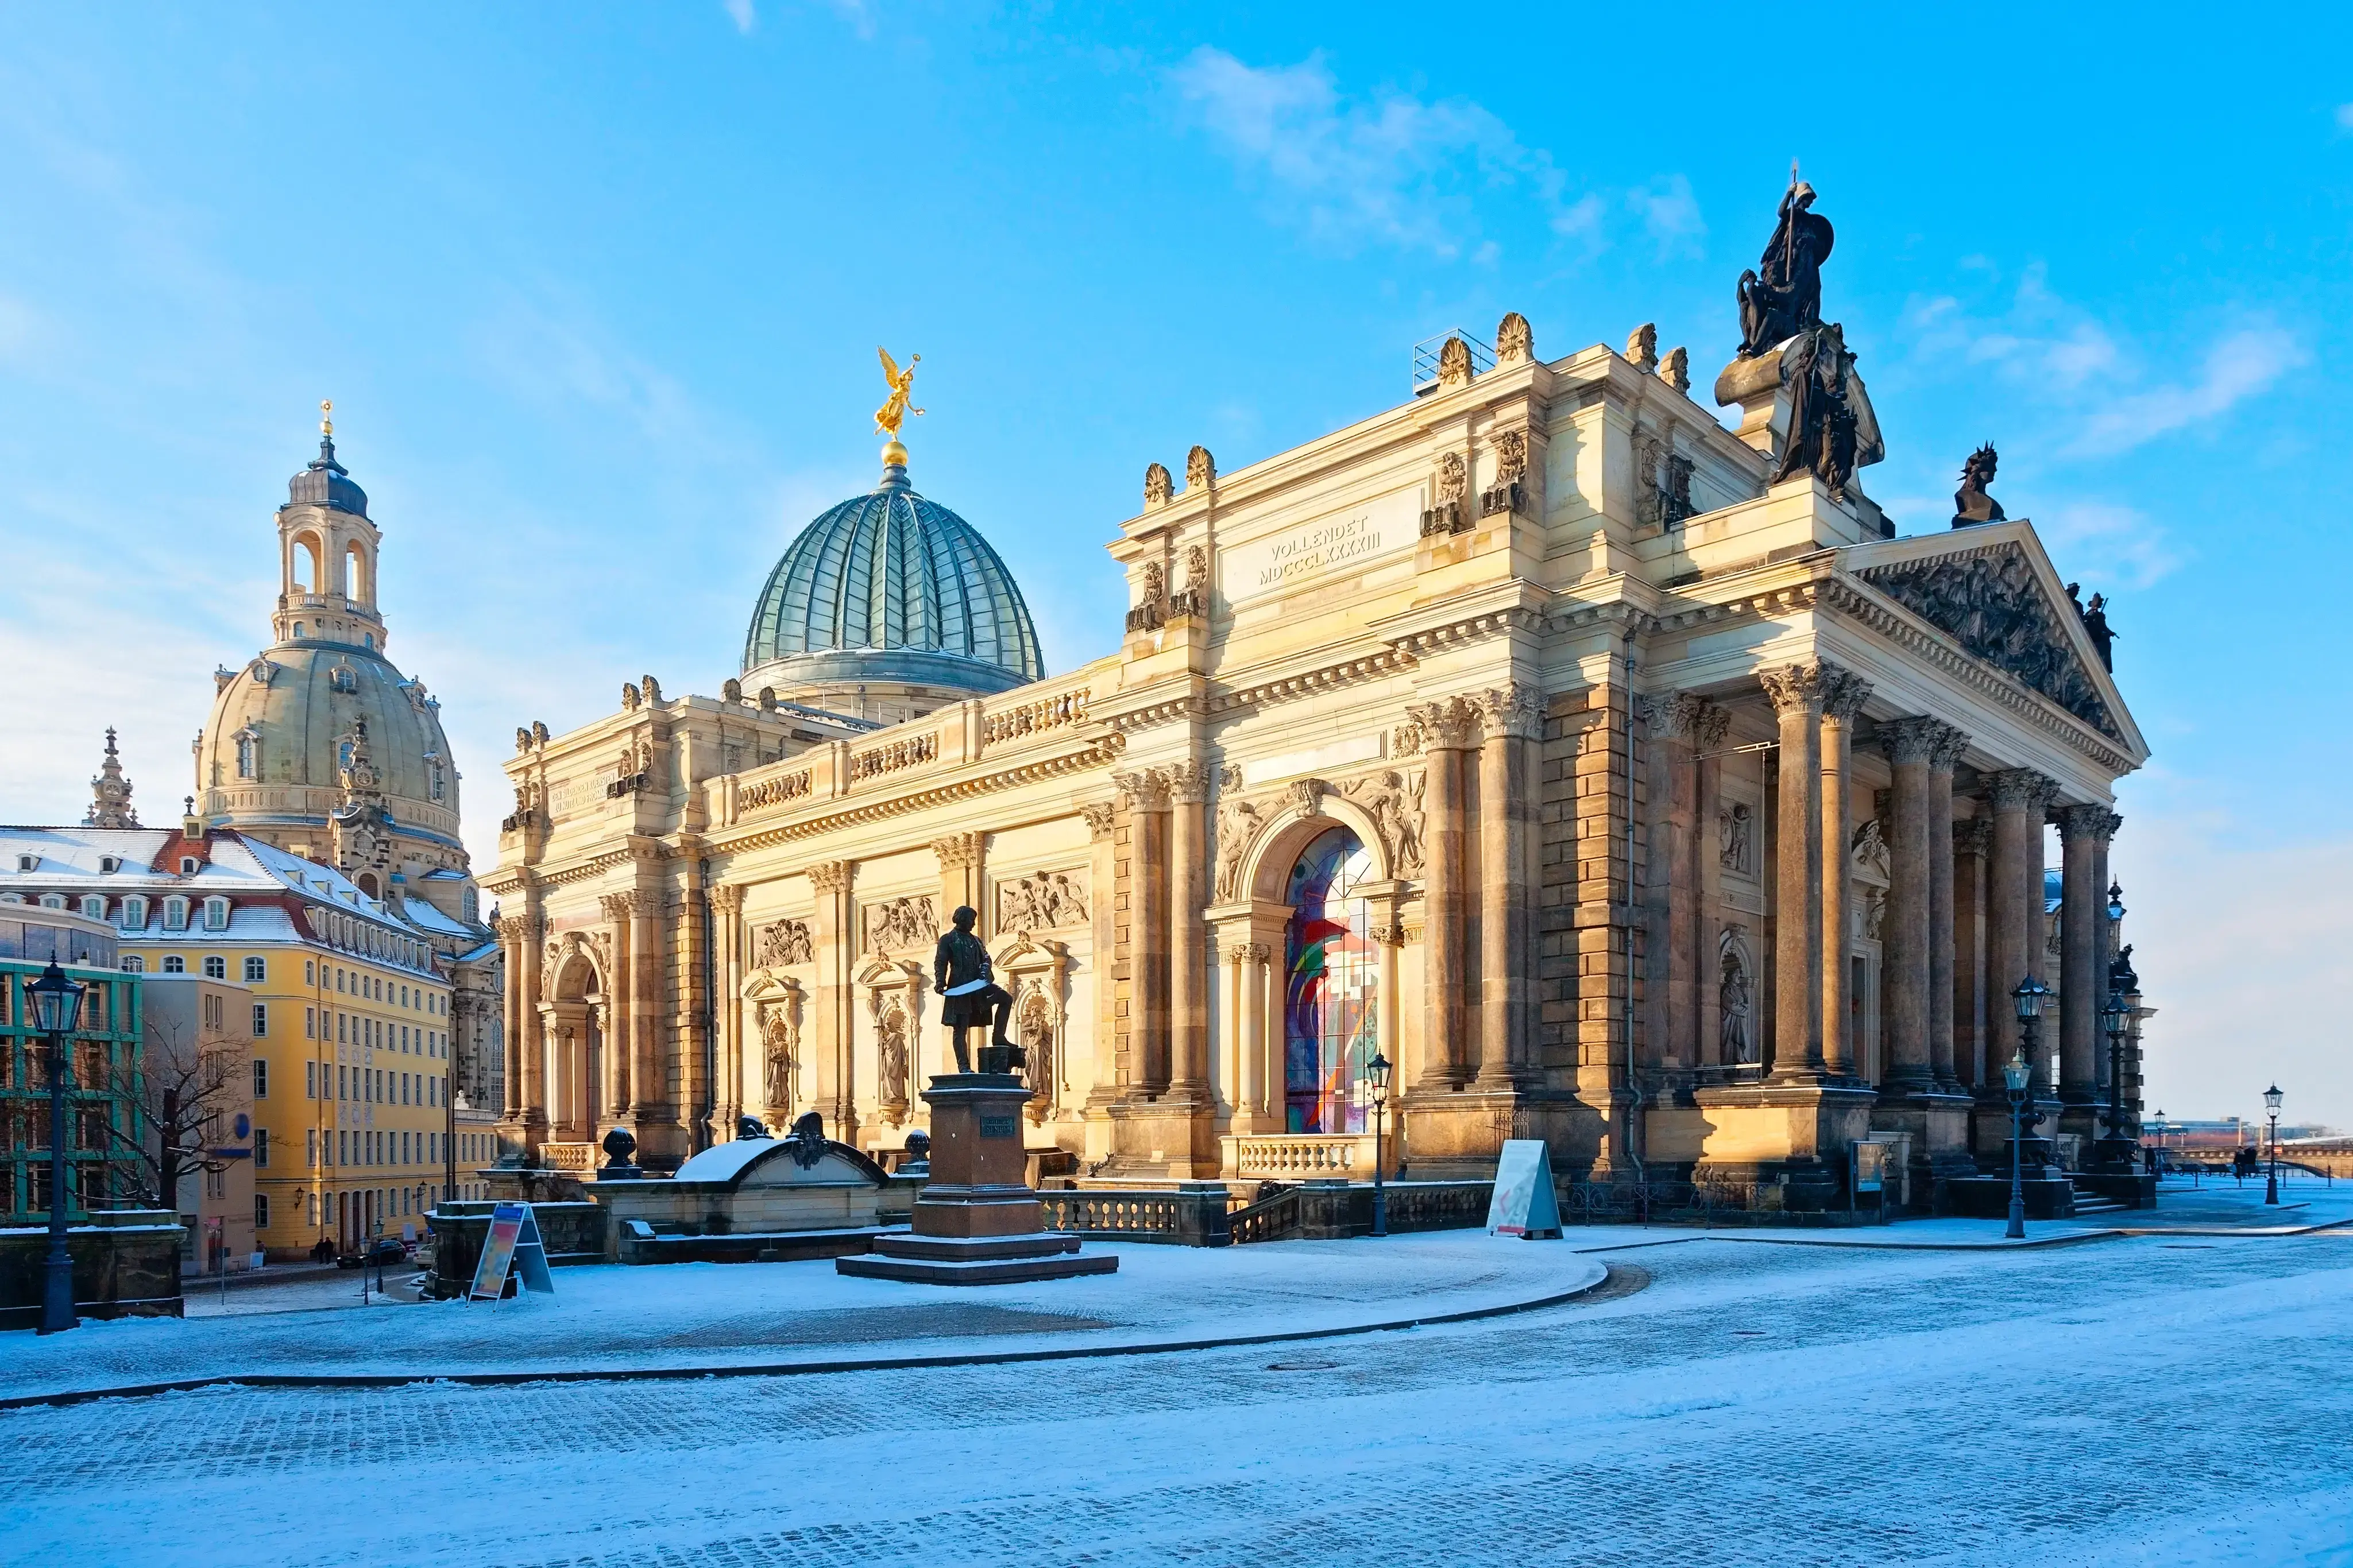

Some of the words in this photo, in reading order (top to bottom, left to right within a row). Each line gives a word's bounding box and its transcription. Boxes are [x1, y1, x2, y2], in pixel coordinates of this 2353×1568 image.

[1272, 516, 1368, 561] VOLLENDET
[1259, 532, 1380, 585] MDCCCLXXXXIII
[552, 791, 562, 802] DEN
[555, 802, 562, 812] ZU
[562, 798, 575, 811] NUTZ
[575, 795, 586, 806] UND
[587, 787, 607, 803] FROMM
